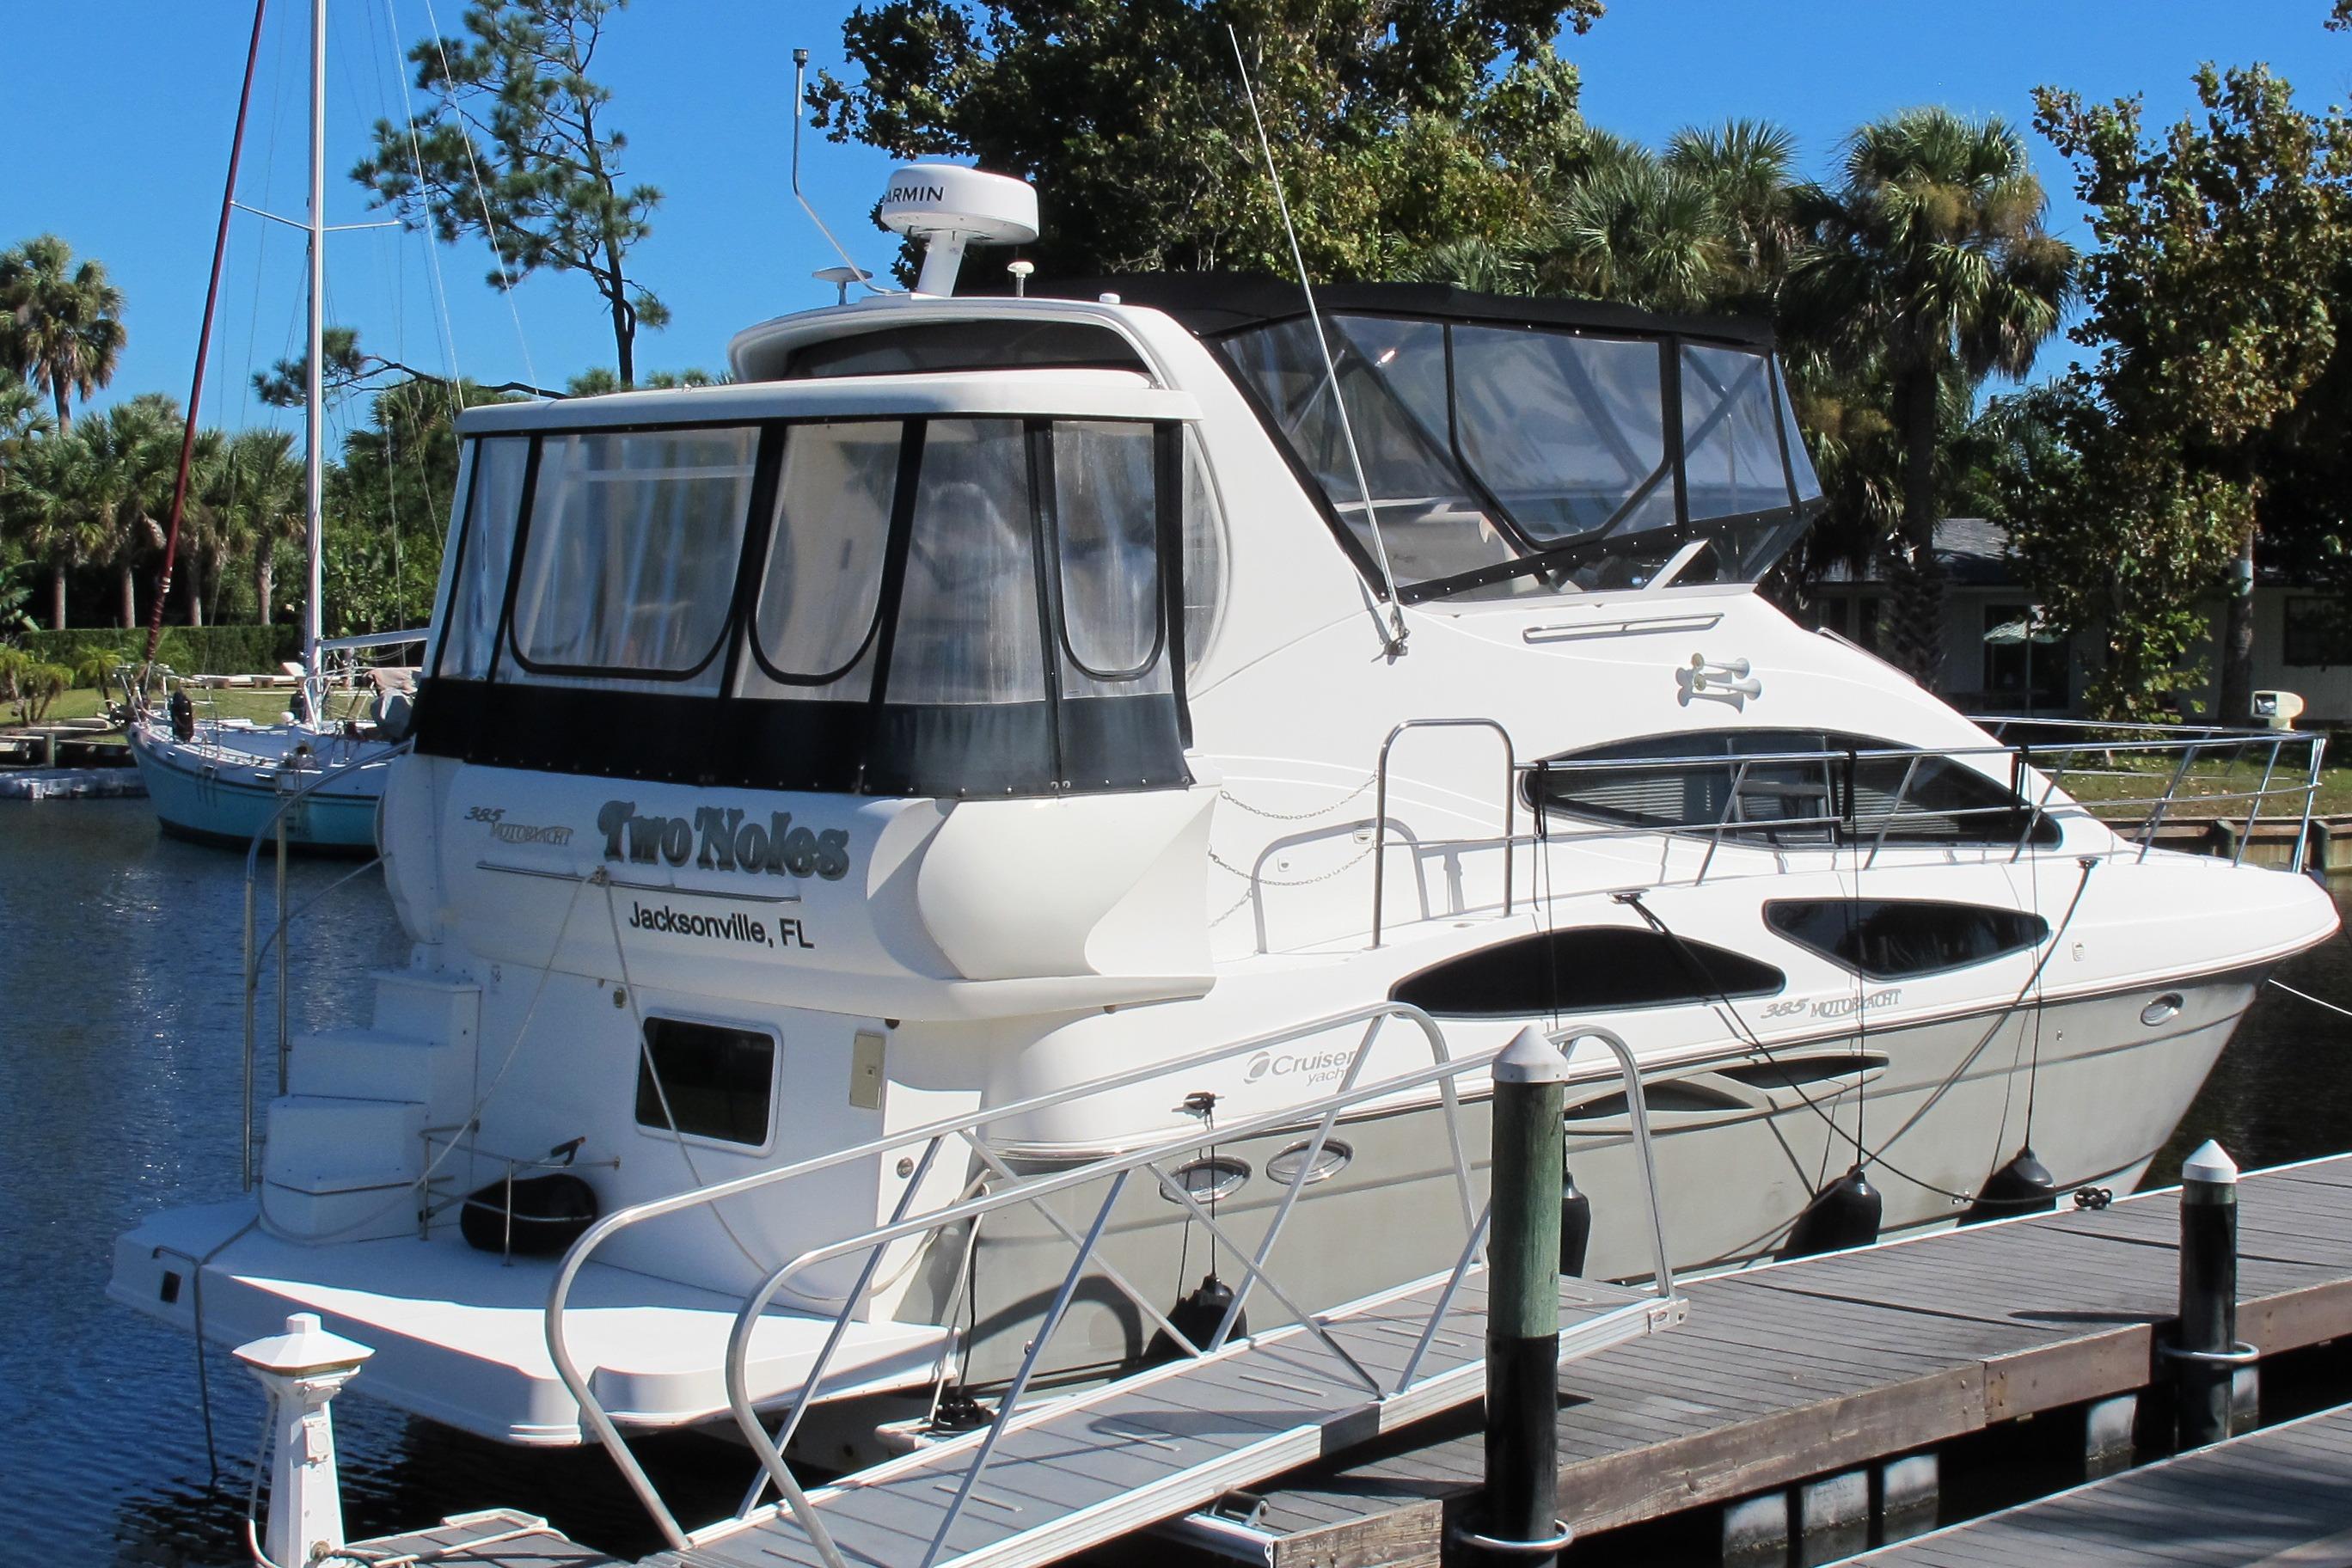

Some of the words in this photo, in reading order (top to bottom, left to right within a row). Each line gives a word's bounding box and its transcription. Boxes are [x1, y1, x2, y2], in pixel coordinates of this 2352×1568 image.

[885, 186, 944, 203] ARMIN
[464, 806, 505, 823] 385
[597, 799, 693, 867] Two
[628, 902, 774, 948] Jacksonville,
[780, 918, 814, 948] FL
[1761, 998, 1810, 1019] 385
[1306, 1069, 1350, 1087] yach
